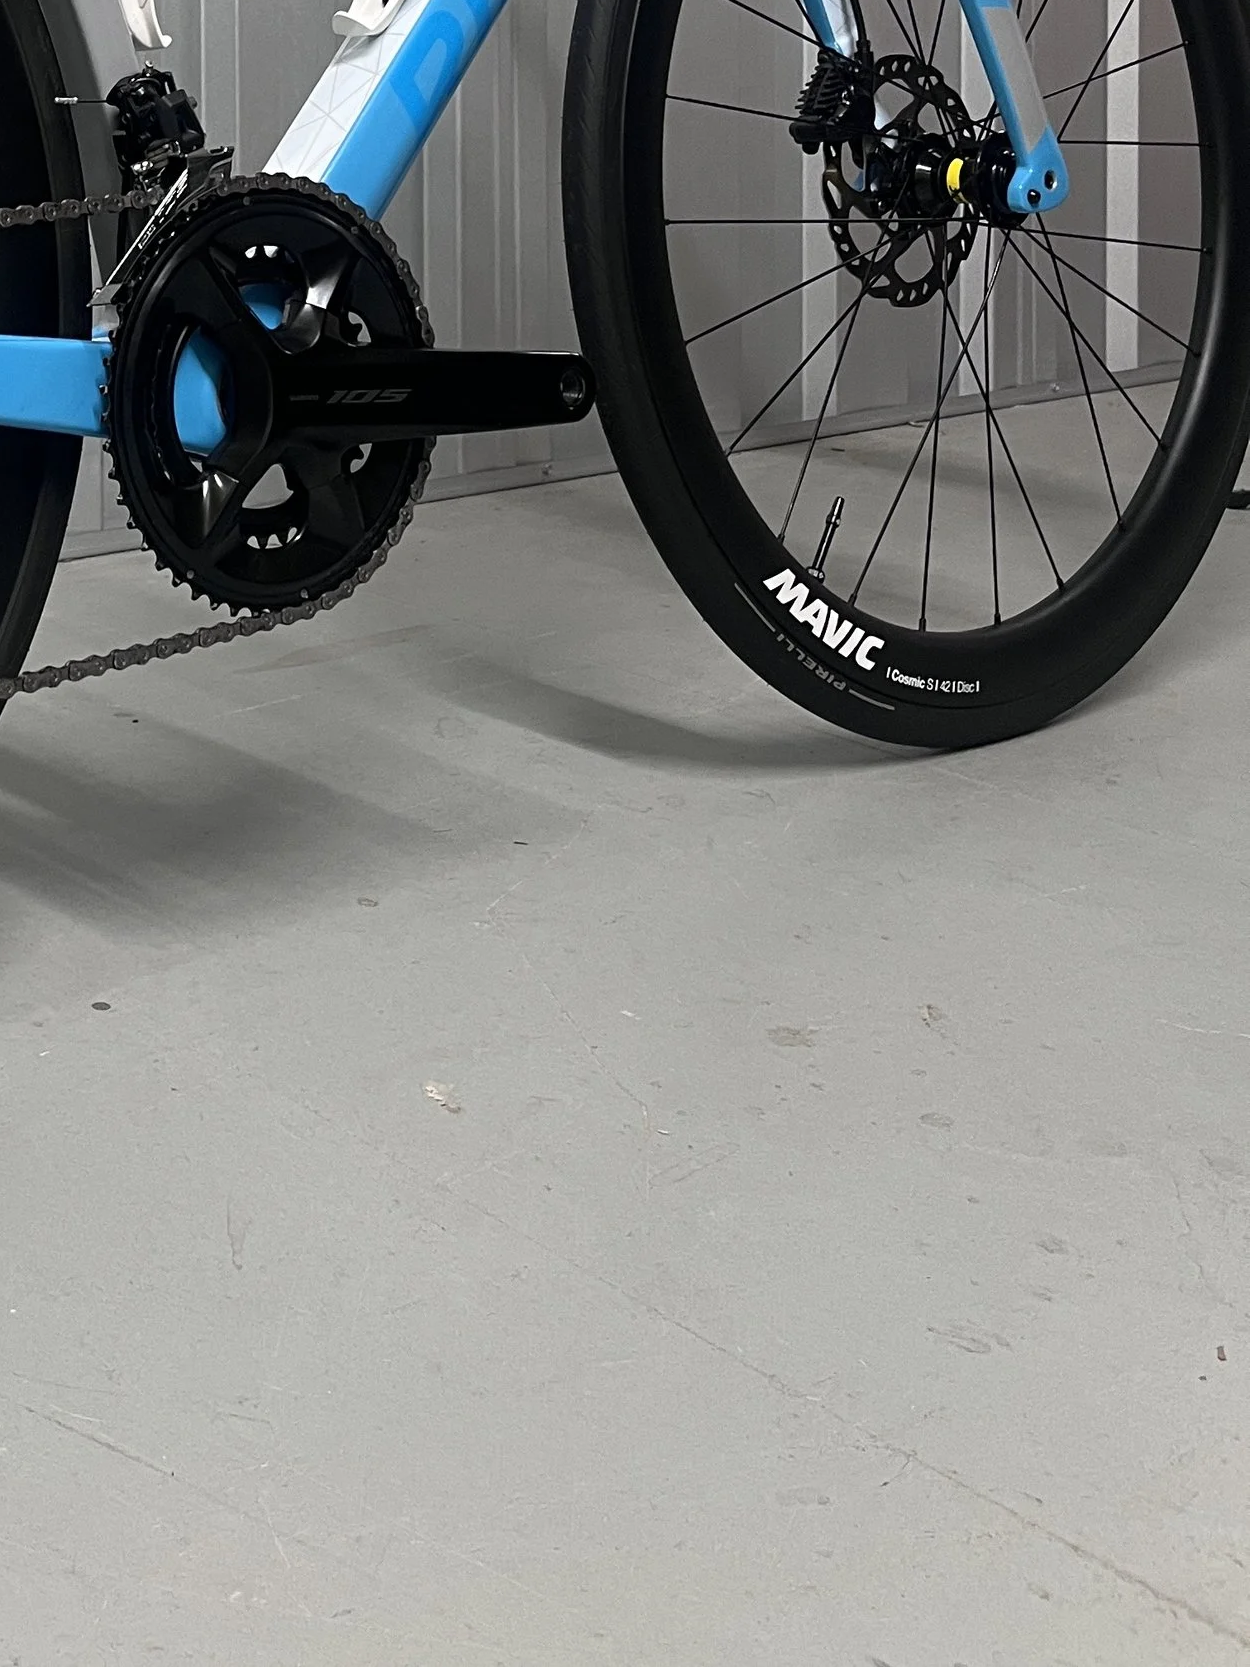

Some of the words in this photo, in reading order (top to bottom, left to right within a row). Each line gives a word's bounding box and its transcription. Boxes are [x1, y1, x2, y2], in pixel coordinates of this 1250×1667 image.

[326, 388, 413, 405] 105
[762, 567, 885, 671] MAVIC
[776, 633, 847, 691] PIRELLI
[891, 668, 926, 689] Cosmic
